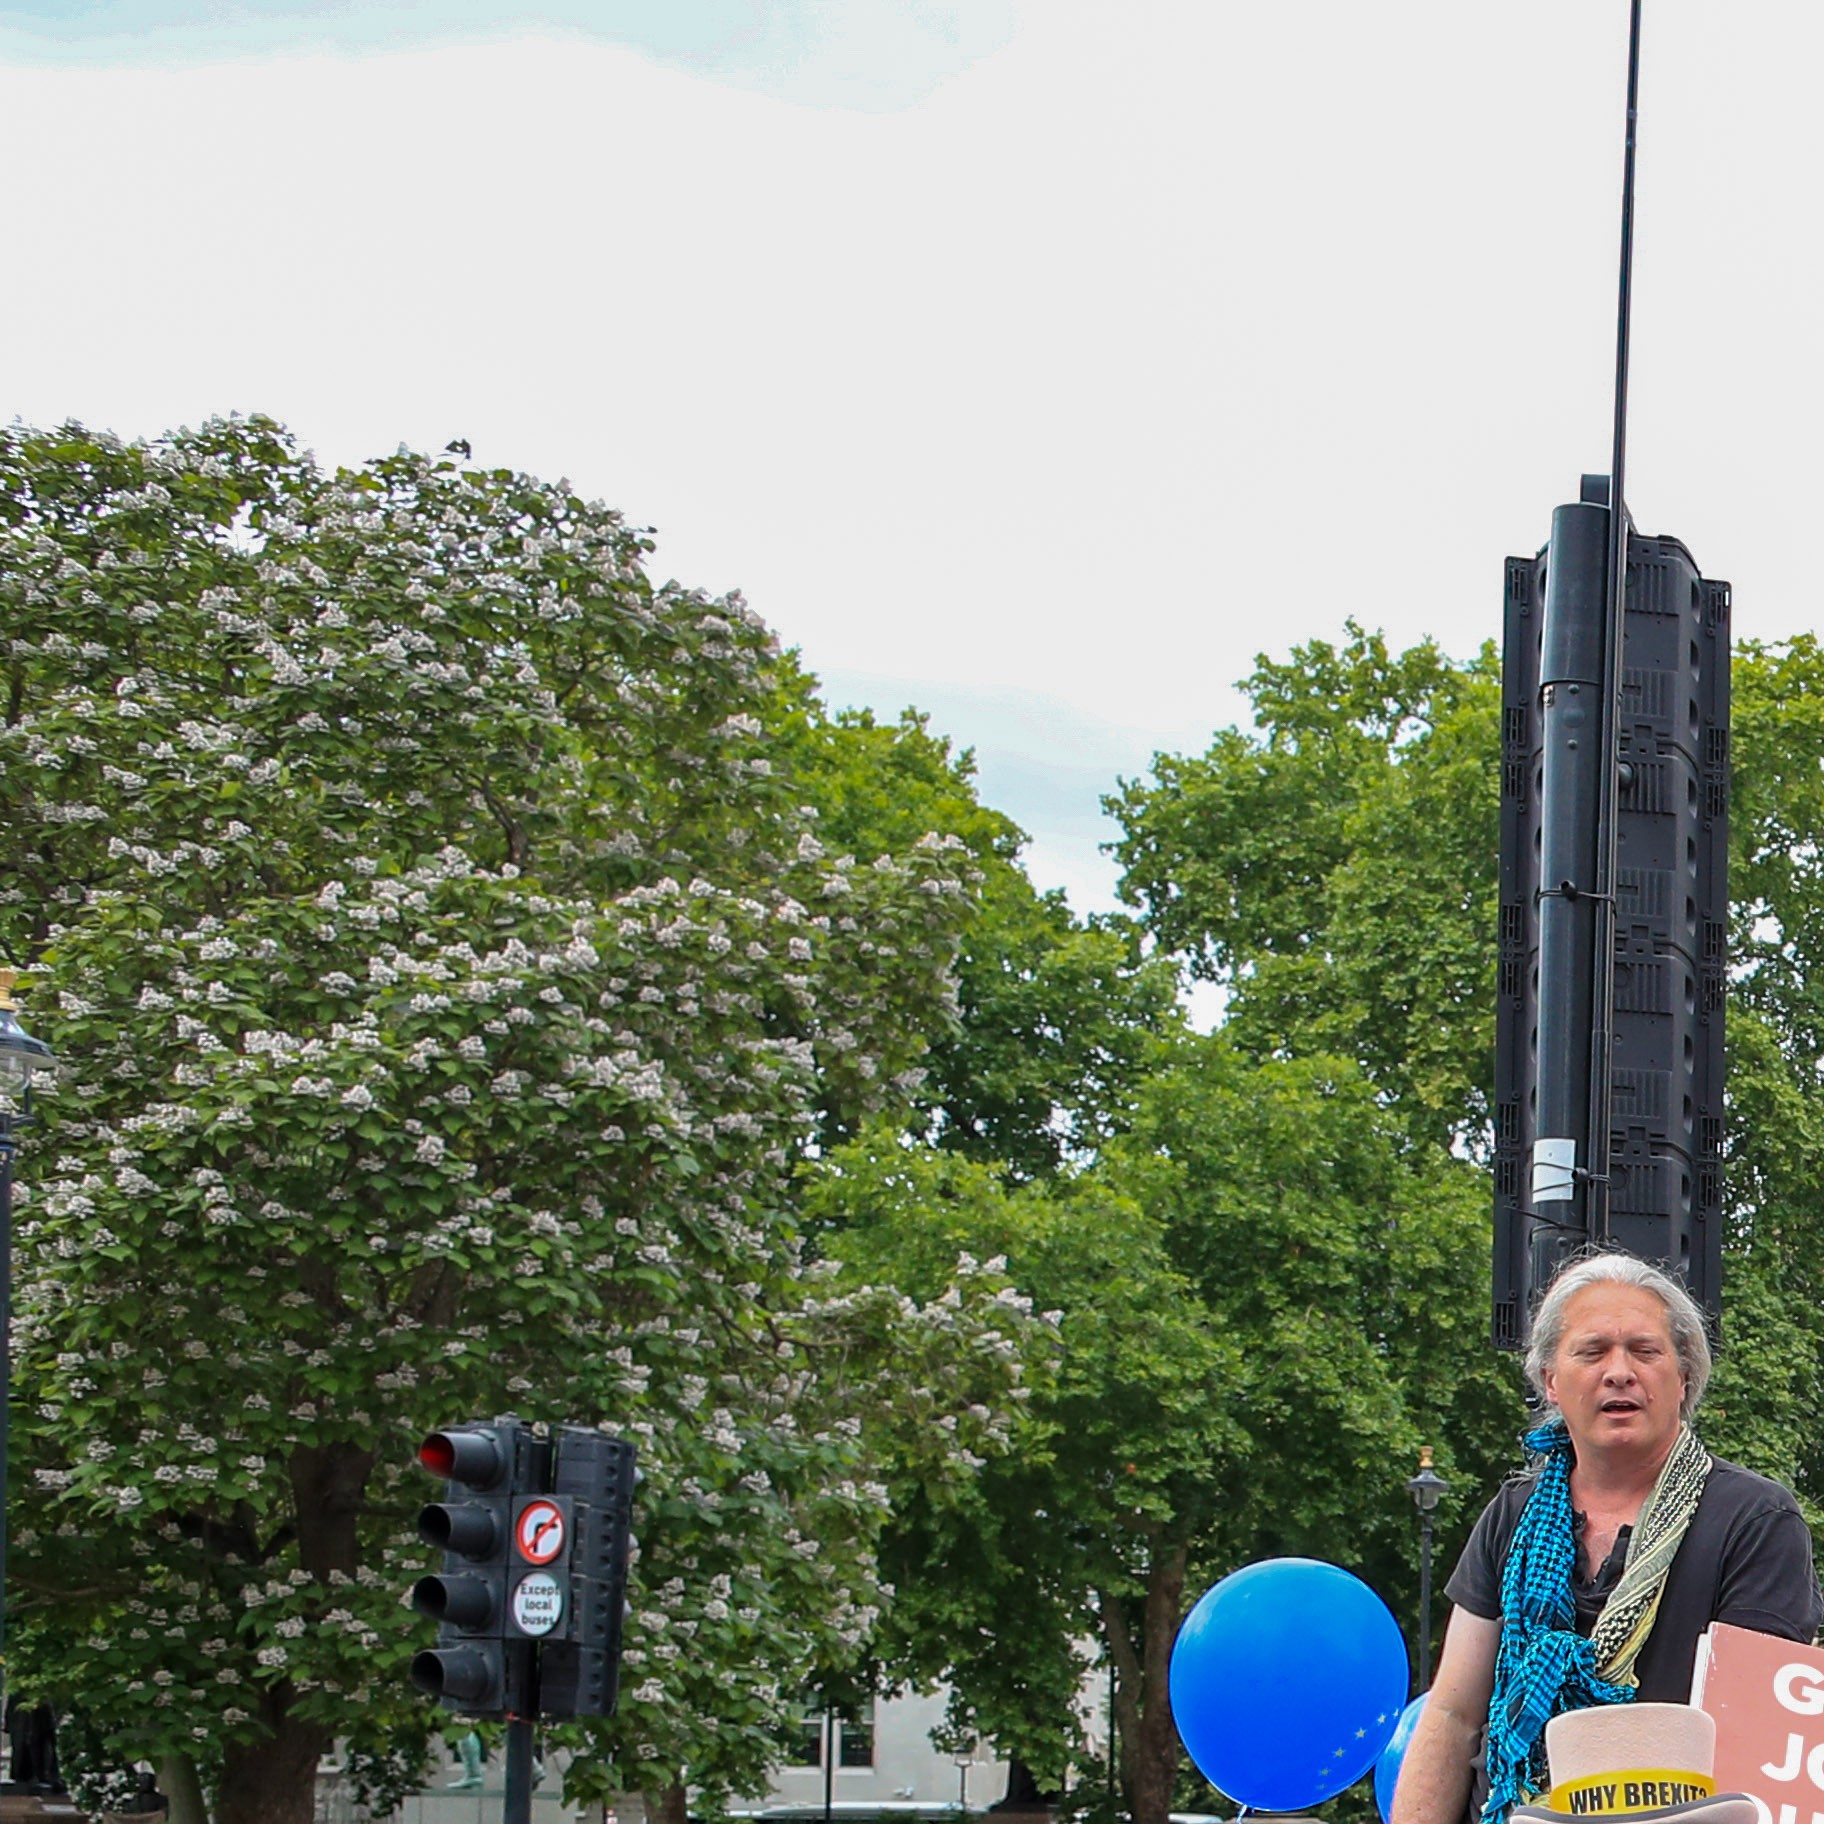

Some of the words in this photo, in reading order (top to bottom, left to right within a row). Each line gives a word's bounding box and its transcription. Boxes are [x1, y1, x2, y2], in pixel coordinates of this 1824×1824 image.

[525, 1599, 552, 1610] local
[521, 1612, 555, 1625] buses
[1569, 1784, 1617, 1815] WHY
